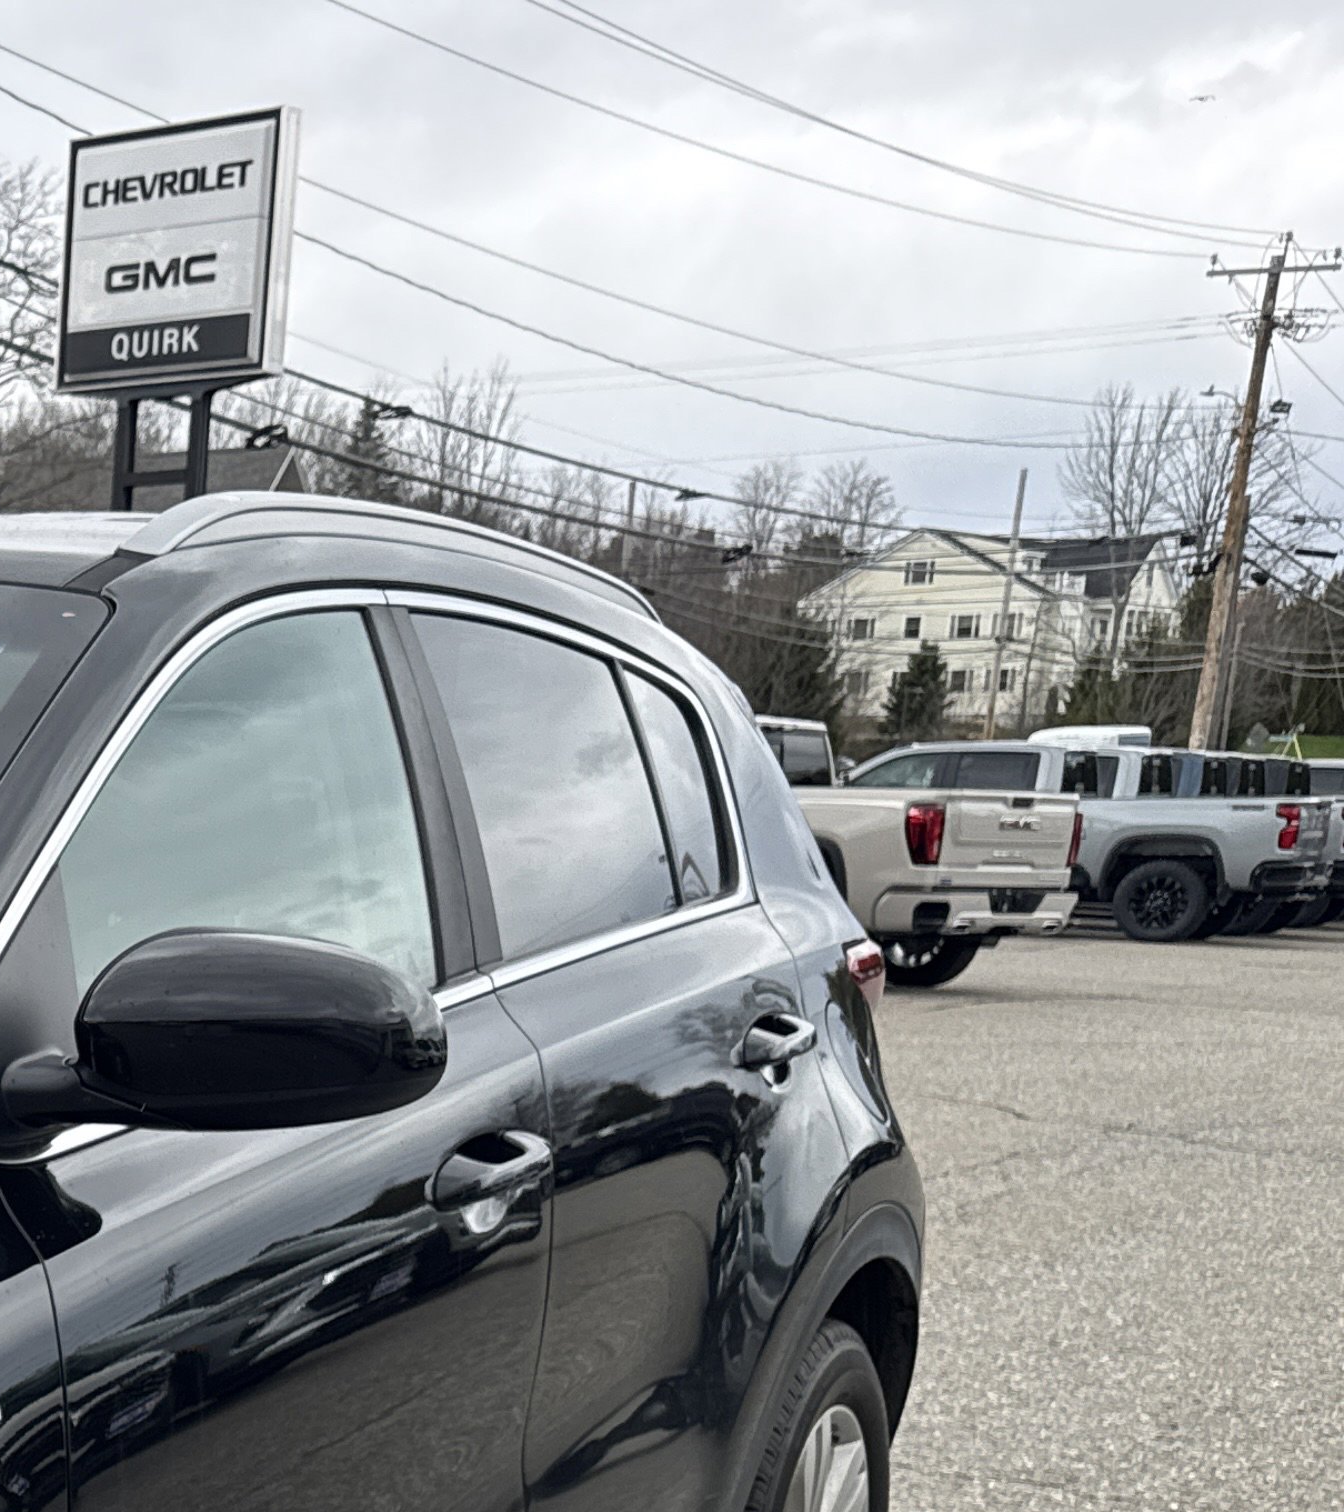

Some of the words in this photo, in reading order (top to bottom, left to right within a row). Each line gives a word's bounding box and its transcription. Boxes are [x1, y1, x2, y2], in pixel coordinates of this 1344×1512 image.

[82, 159, 254, 209] CHEVROLET
[104, 253, 217, 294] GMC
[111, 324, 201, 361] QUIRK
